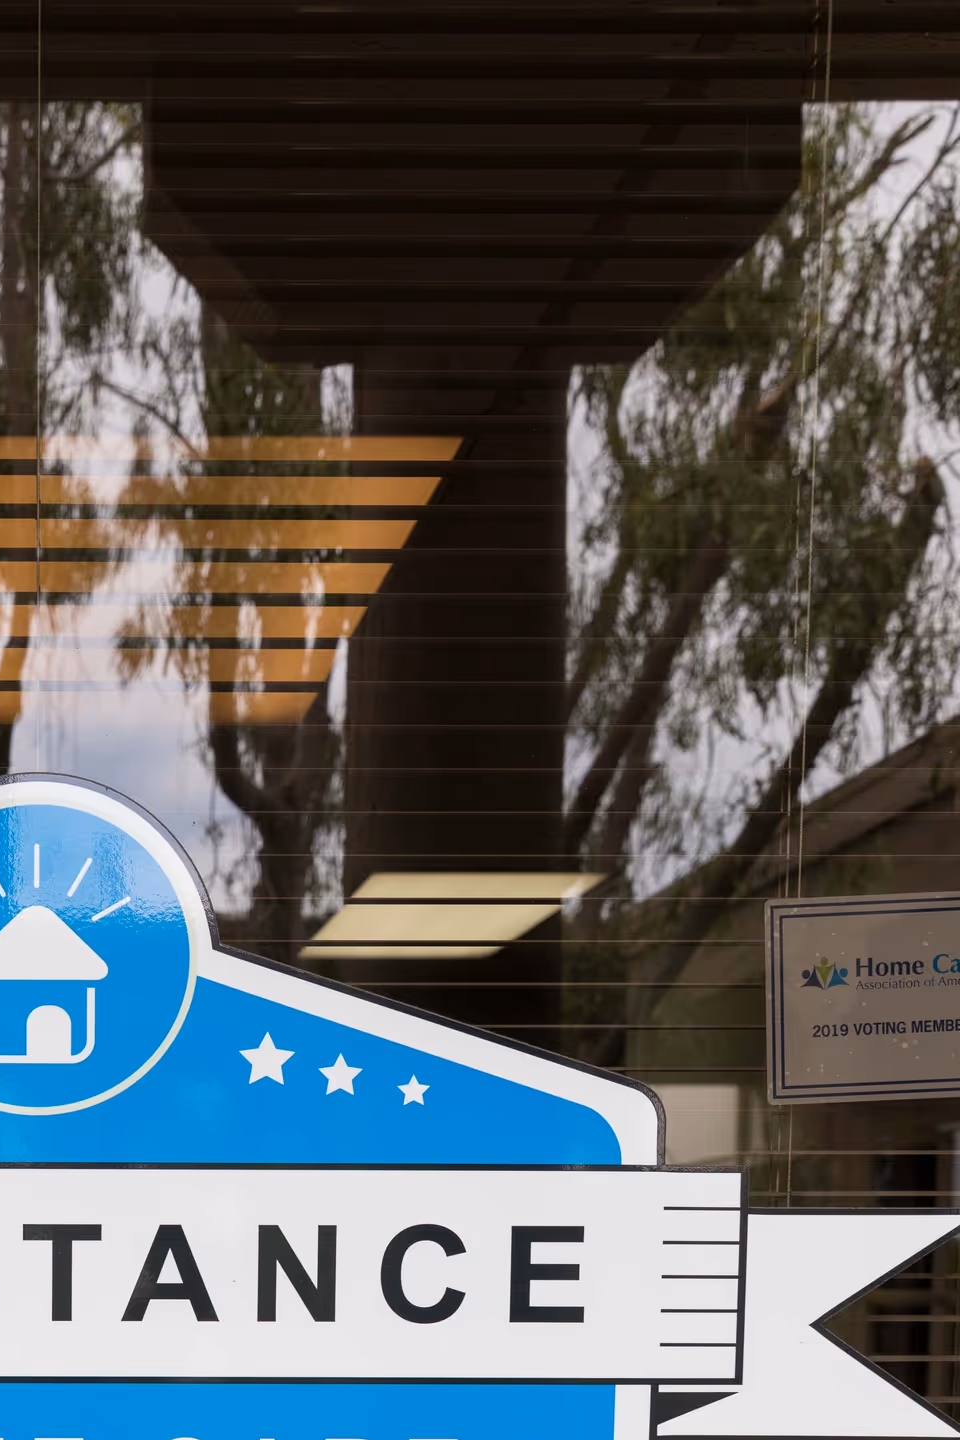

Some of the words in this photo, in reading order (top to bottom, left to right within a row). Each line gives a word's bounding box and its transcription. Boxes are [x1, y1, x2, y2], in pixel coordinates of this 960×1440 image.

[856, 958, 924, 977] Home
[856, 979, 920, 990] Association
[924, 976, 935, 987] of
[812, 1024, 848, 1037] 2019
[853, 1022, 906, 1035] VOTING
